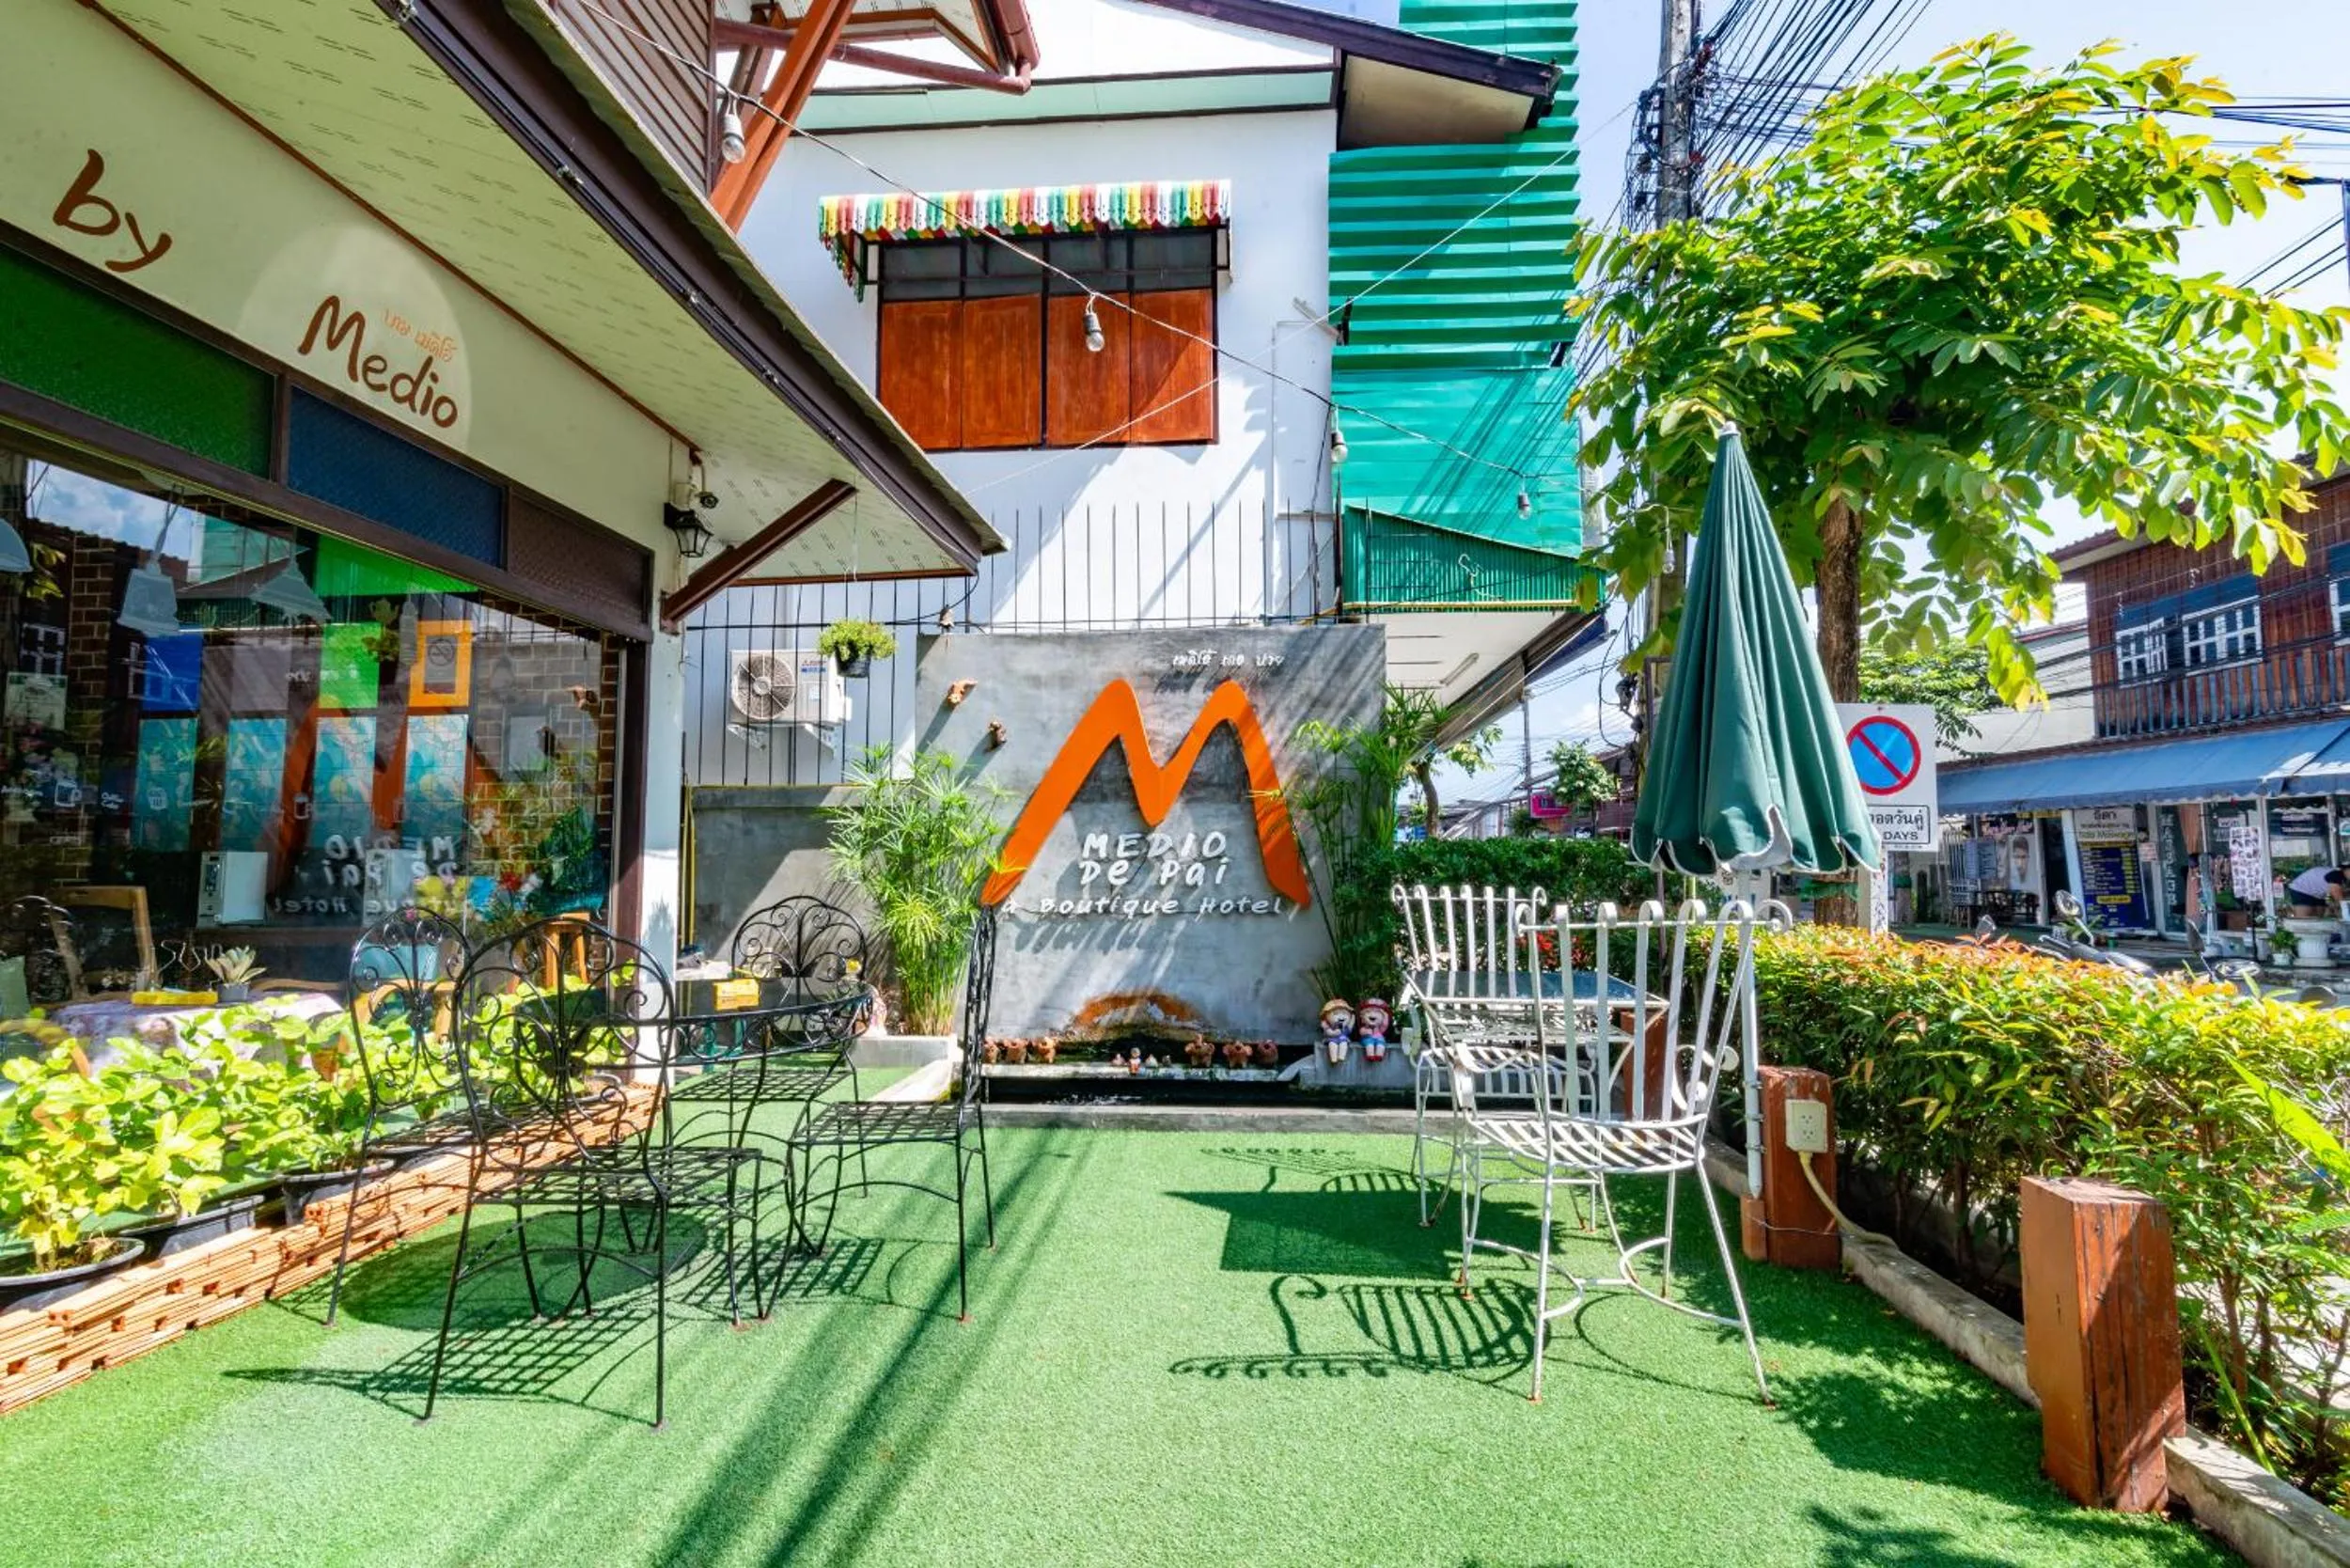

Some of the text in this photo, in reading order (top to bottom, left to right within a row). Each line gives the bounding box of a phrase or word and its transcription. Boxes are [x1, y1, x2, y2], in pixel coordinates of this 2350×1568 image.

[53, 149, 172, 272] by
[297, 294, 458, 428] Medio
[1082, 831, 1227, 858] MEDIO
[1883, 831, 1919, 840] DAYS
[1040, 898, 1181, 918] Boutique
[1199, 897, 1281, 915] Hotel
